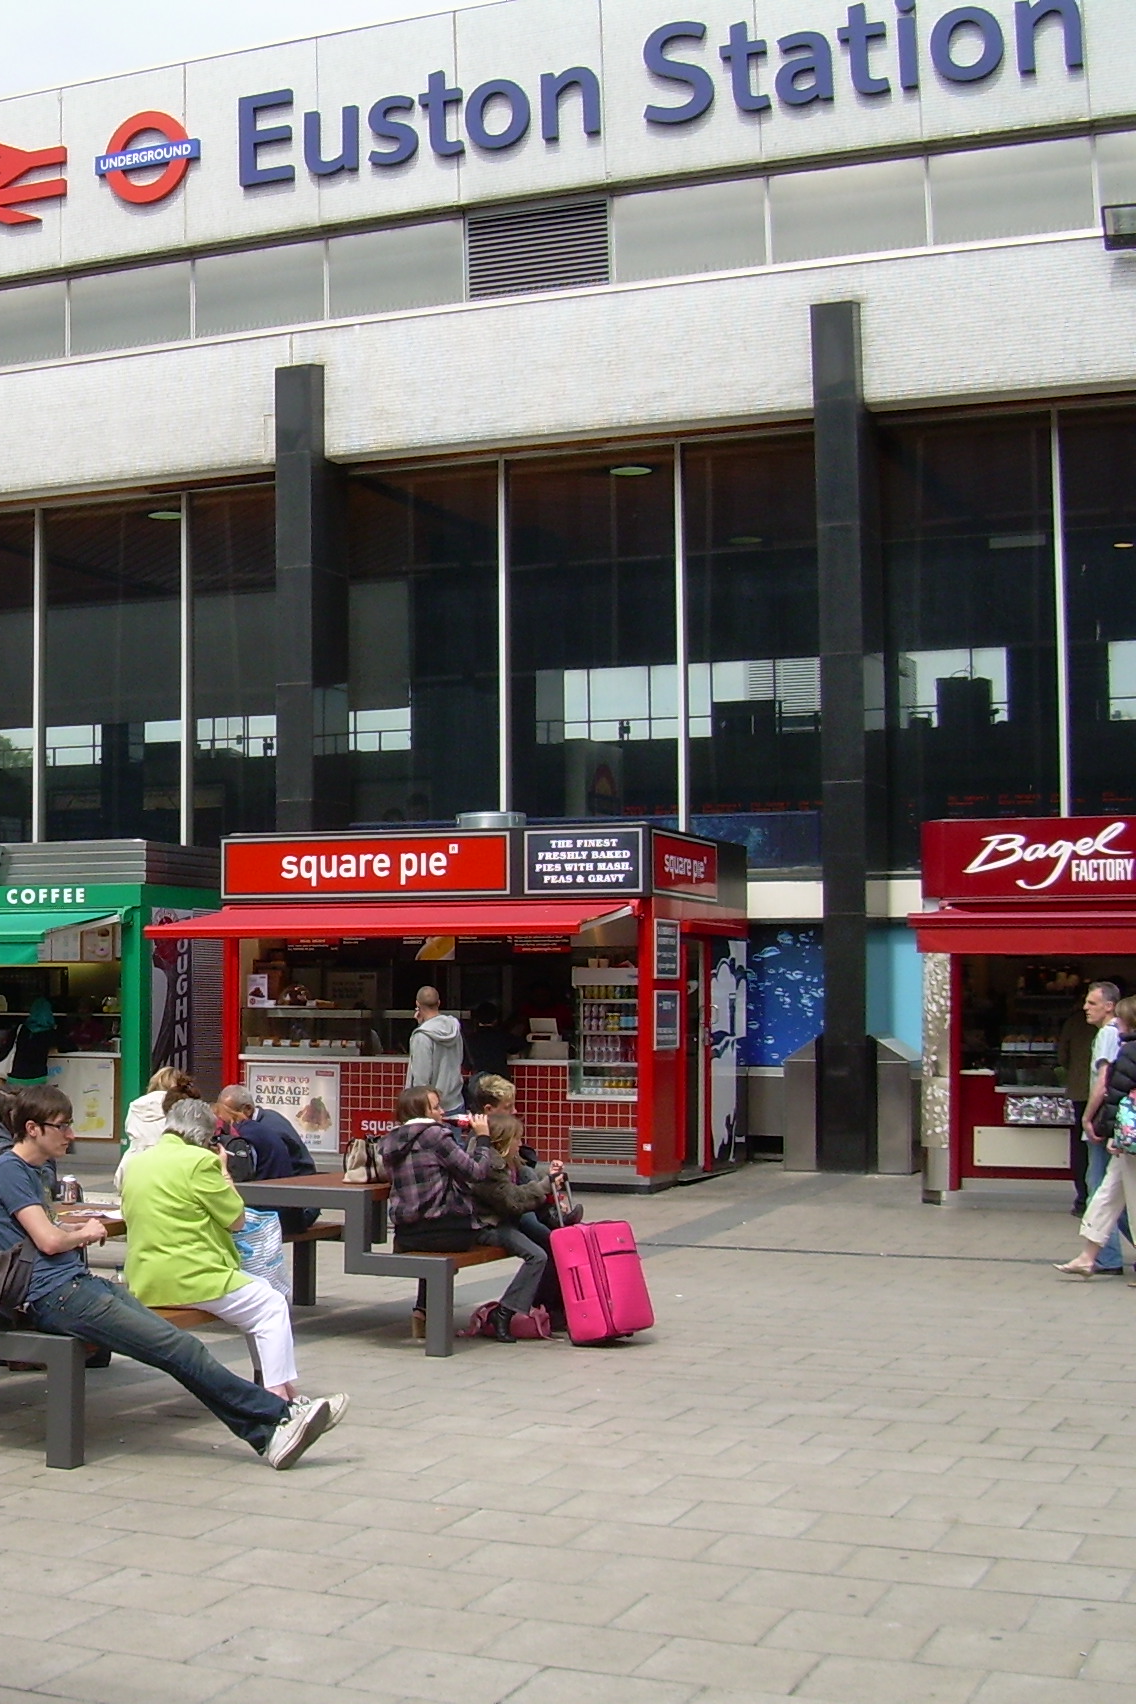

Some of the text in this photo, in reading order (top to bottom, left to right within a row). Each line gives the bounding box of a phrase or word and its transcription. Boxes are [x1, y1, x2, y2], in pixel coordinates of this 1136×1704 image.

[238, 0, 1084, 187] Euston Station
[100, 143, 191, 170] UNDERGROUND
[550, 838, 618, 848] THE FINEST
[537, 850, 631, 860] FRESHLY BAKED
[962, 822, 1135, 890] Bagel FACTORY
[280, 851, 447, 887] square pie
[535, 863, 562, 872] PIES
[564, 862, 594, 871] WITH
[664, 854, 692, 880] square
[543, 873, 625, 883] PEAS & GRAVY
[6, 887, 86, 905] COFFEE
[255, 1084, 310, 1096] SAUSAGE
[255, 1094, 301, 1106] & MASH
[361, 1119, 399, 1135] squa
